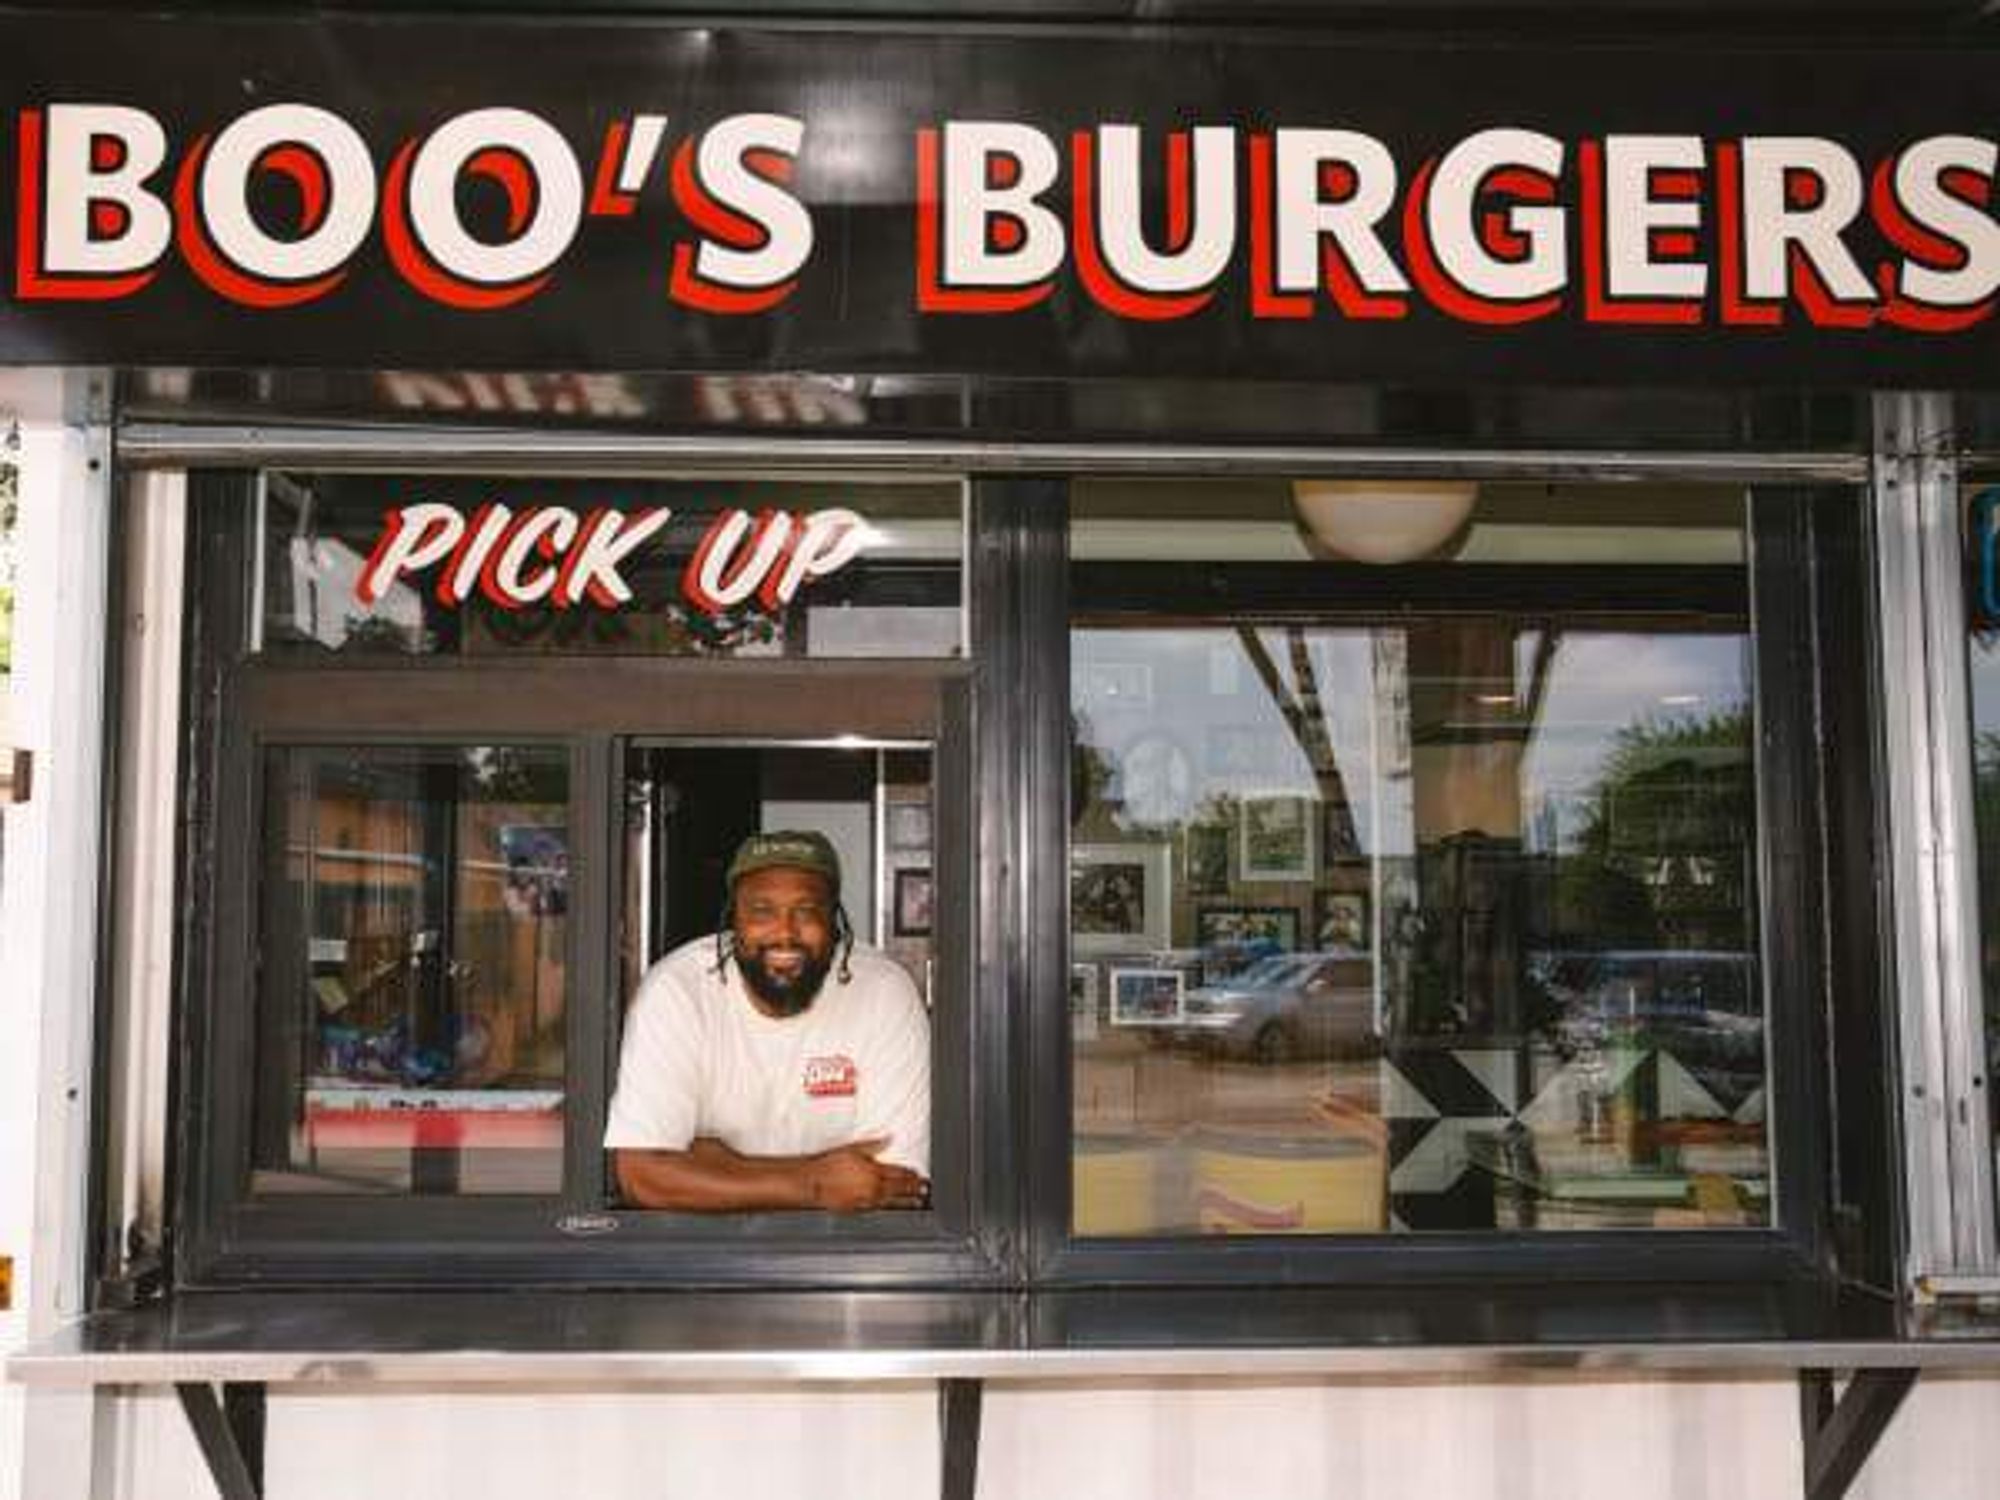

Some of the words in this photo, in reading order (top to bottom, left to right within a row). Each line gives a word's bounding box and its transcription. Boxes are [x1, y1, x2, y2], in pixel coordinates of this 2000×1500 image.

[17, 104, 815, 313] BOO'S
[917, 122, 2000, 331] BURGERS
[357, 502, 671, 610] PICK
[683, 507, 872, 614] UP
